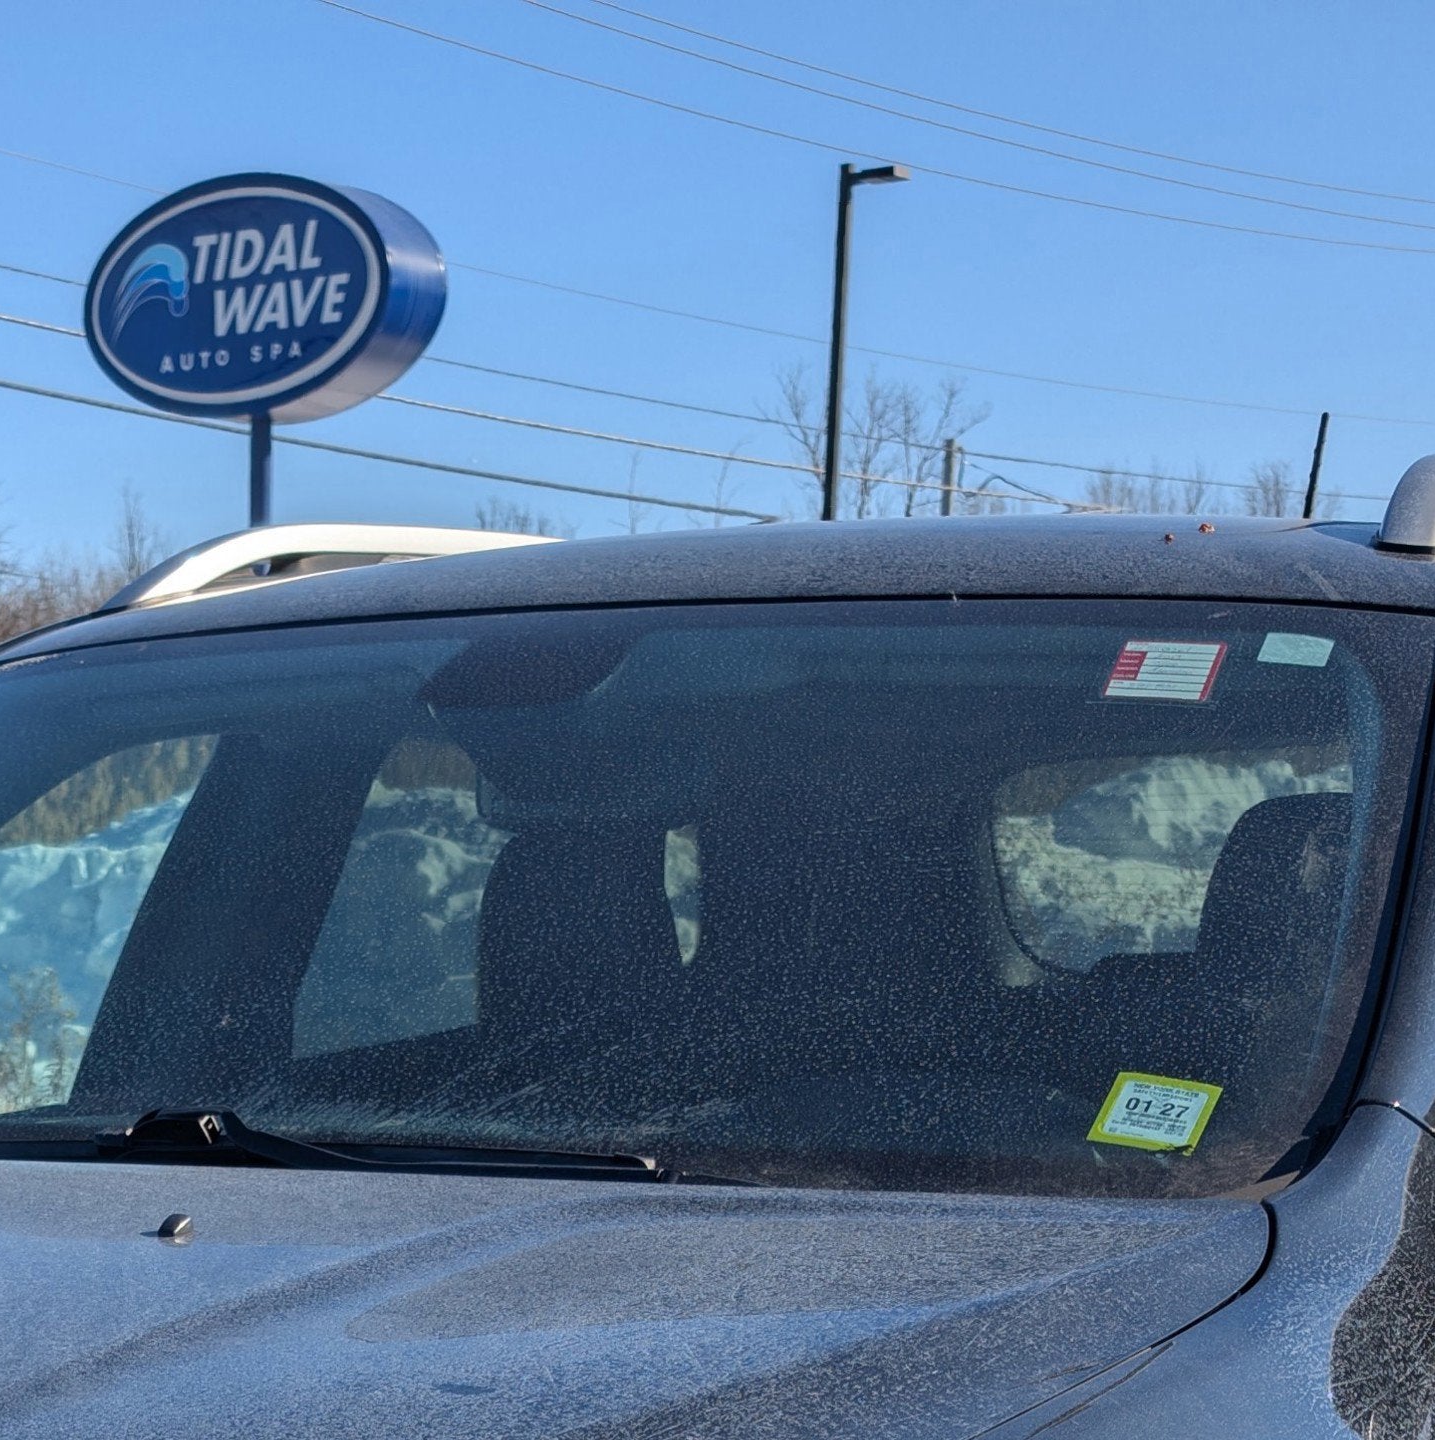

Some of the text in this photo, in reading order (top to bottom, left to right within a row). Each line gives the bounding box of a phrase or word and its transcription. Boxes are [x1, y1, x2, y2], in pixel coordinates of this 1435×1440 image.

[191, 219, 322, 285] TIDAL
[213, 273, 352, 338] WAVE
[159, 340, 303, 374] AUTO SPA
[1125, 1097, 1190, 1118] 01 27
